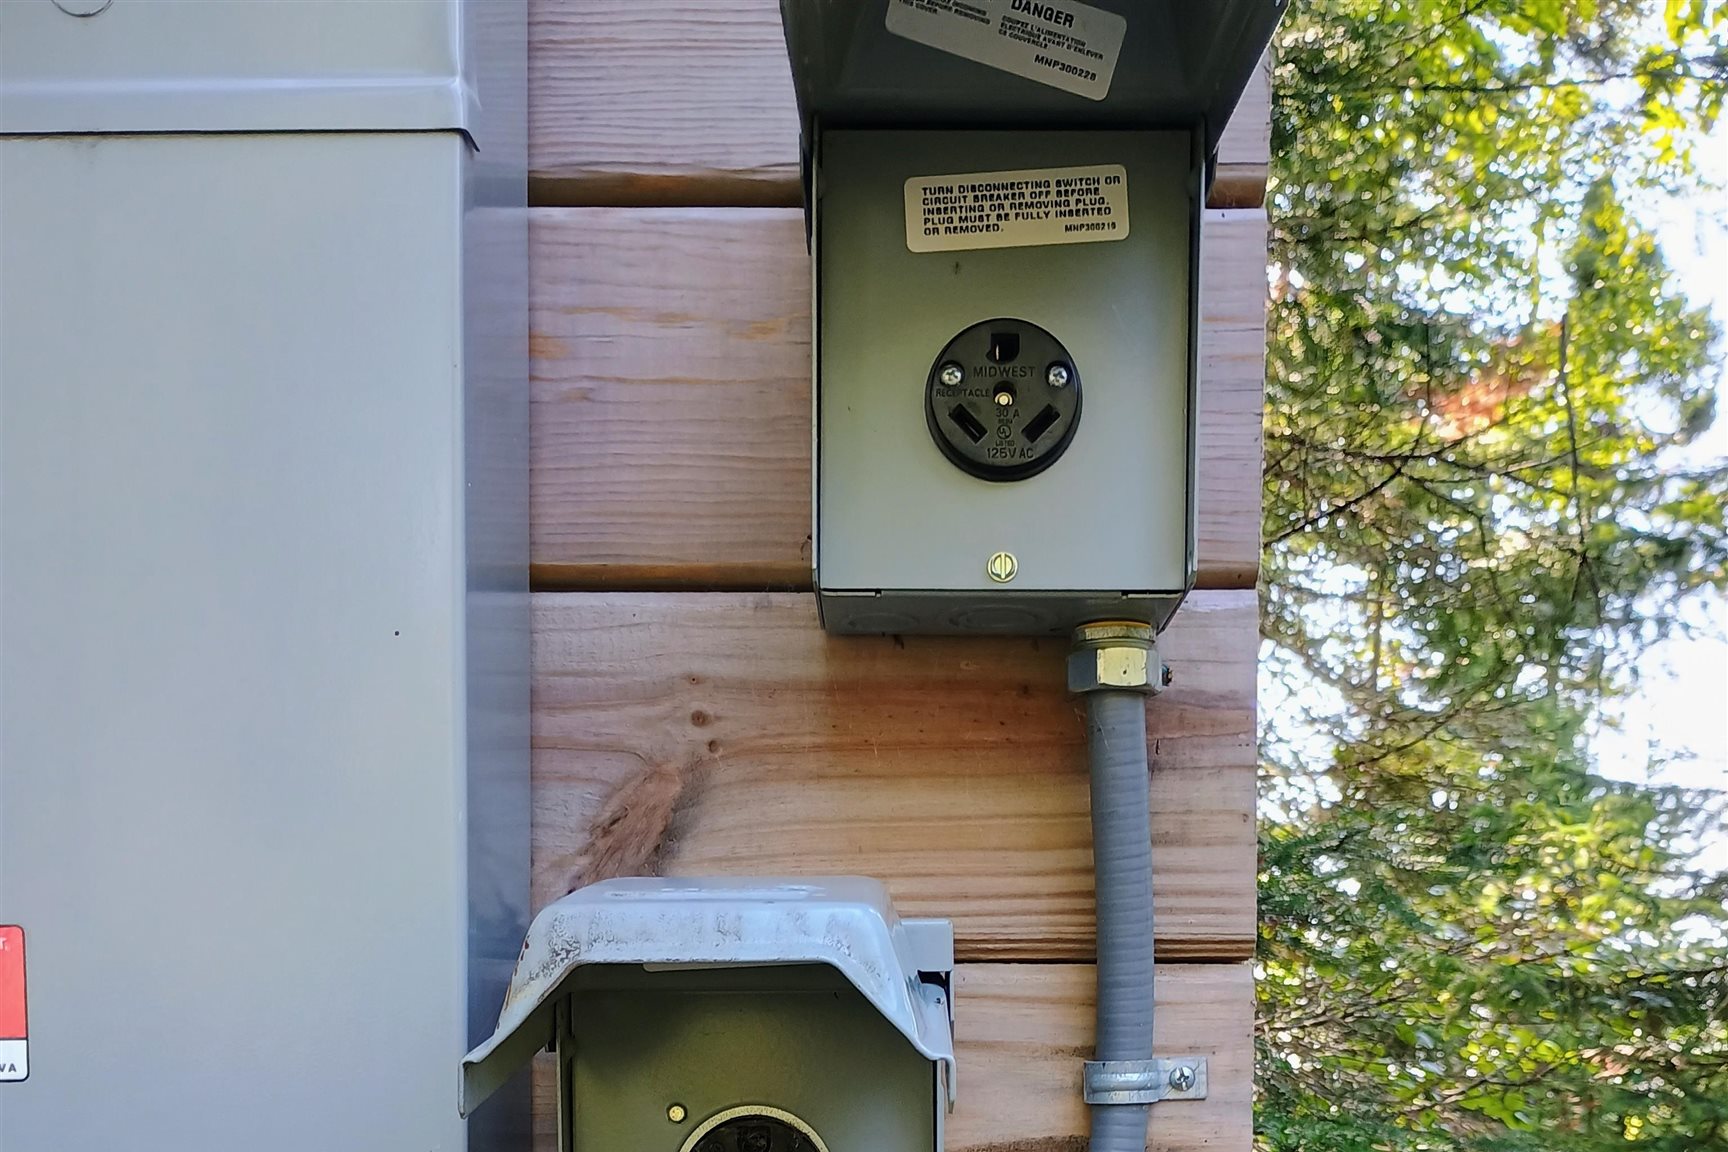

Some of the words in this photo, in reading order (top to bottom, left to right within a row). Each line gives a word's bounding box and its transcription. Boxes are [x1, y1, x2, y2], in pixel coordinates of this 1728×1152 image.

[1011, 0, 1075, 28] DANGER
[1042, 35, 1065, 49] AVANT
[922, 186, 954, 197] TURN
[958, 179, 1051, 194] DISCONNECTING
[1055, 176, 1100, 188] SWITCH
[1105, 175, 1121, 185] OR
[922, 195, 968, 206] CIRCUIT
[973, 192, 1025, 203] BREAKER
[1030, 190, 1051, 200] OFF
[1056, 187, 1100, 198] BEFORE
[922, 204, 985, 216] INSERTING
[989, 202, 1005, 213] OR
[1009, 199, 1071, 211] REMOVING
[1075, 197, 1110, 208] PLUG.
[923, 215, 955, 226] PLUG
[958, 213, 991, 224] MUST
[996, 211, 1010, 222] BE
[1014, 209, 1051, 221] FULLY
[1055, 206, 1112, 218] INSERTED
[924, 226, 942, 236] OR
[945, 223, 1004, 235] REMOVED.
[973, 366, 1036, 377] MIDWEST
[935, 388, 990, 398] RECEPTACLE
[995, 407, 1009, 418] 30
